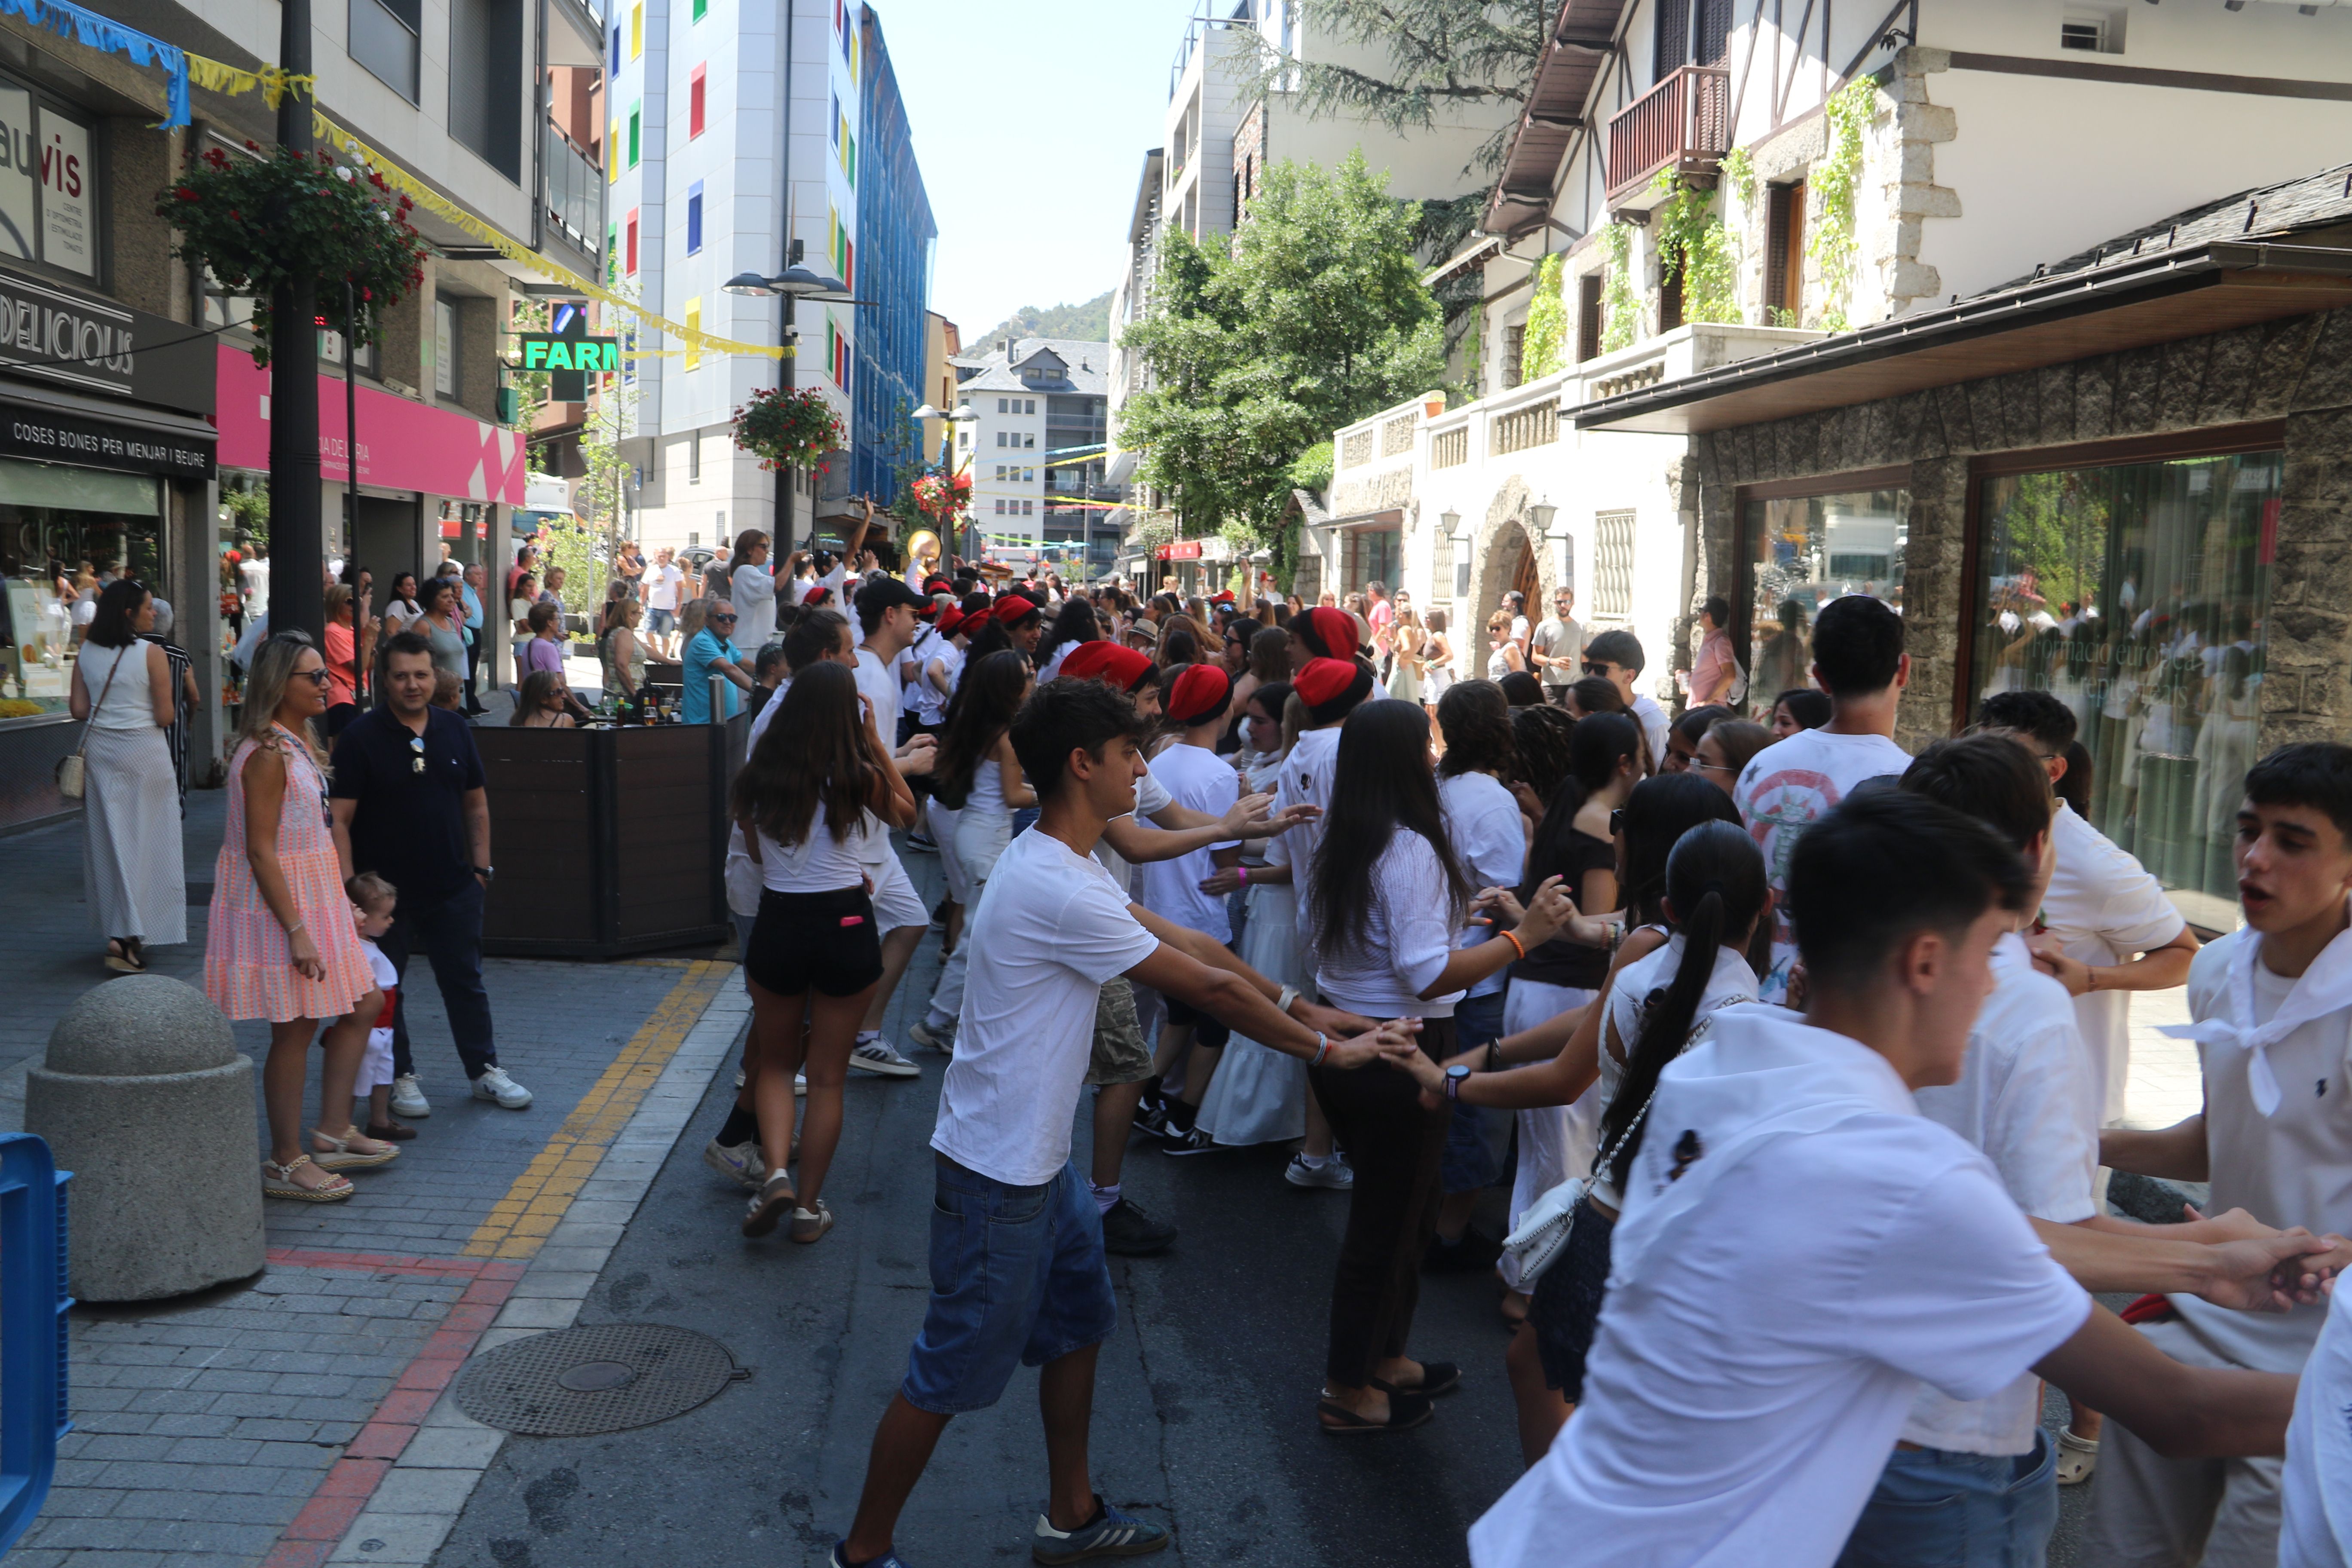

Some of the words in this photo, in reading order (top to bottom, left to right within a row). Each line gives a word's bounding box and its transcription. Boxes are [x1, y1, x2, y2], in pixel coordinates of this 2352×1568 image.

[63, 202, 83, 217] CENTRE
[0, 294, 134, 376] DELICIOUS
[14, 422, 55, 445] COSES
[59, 430, 99, 452] BONES
[101, 438, 124, 456] PER
[126, 441, 167, 461] MENJAR
[169, 448, 173, 462] I
[175, 449, 205, 468] BEURE
[331, 438, 344, 457] DE
